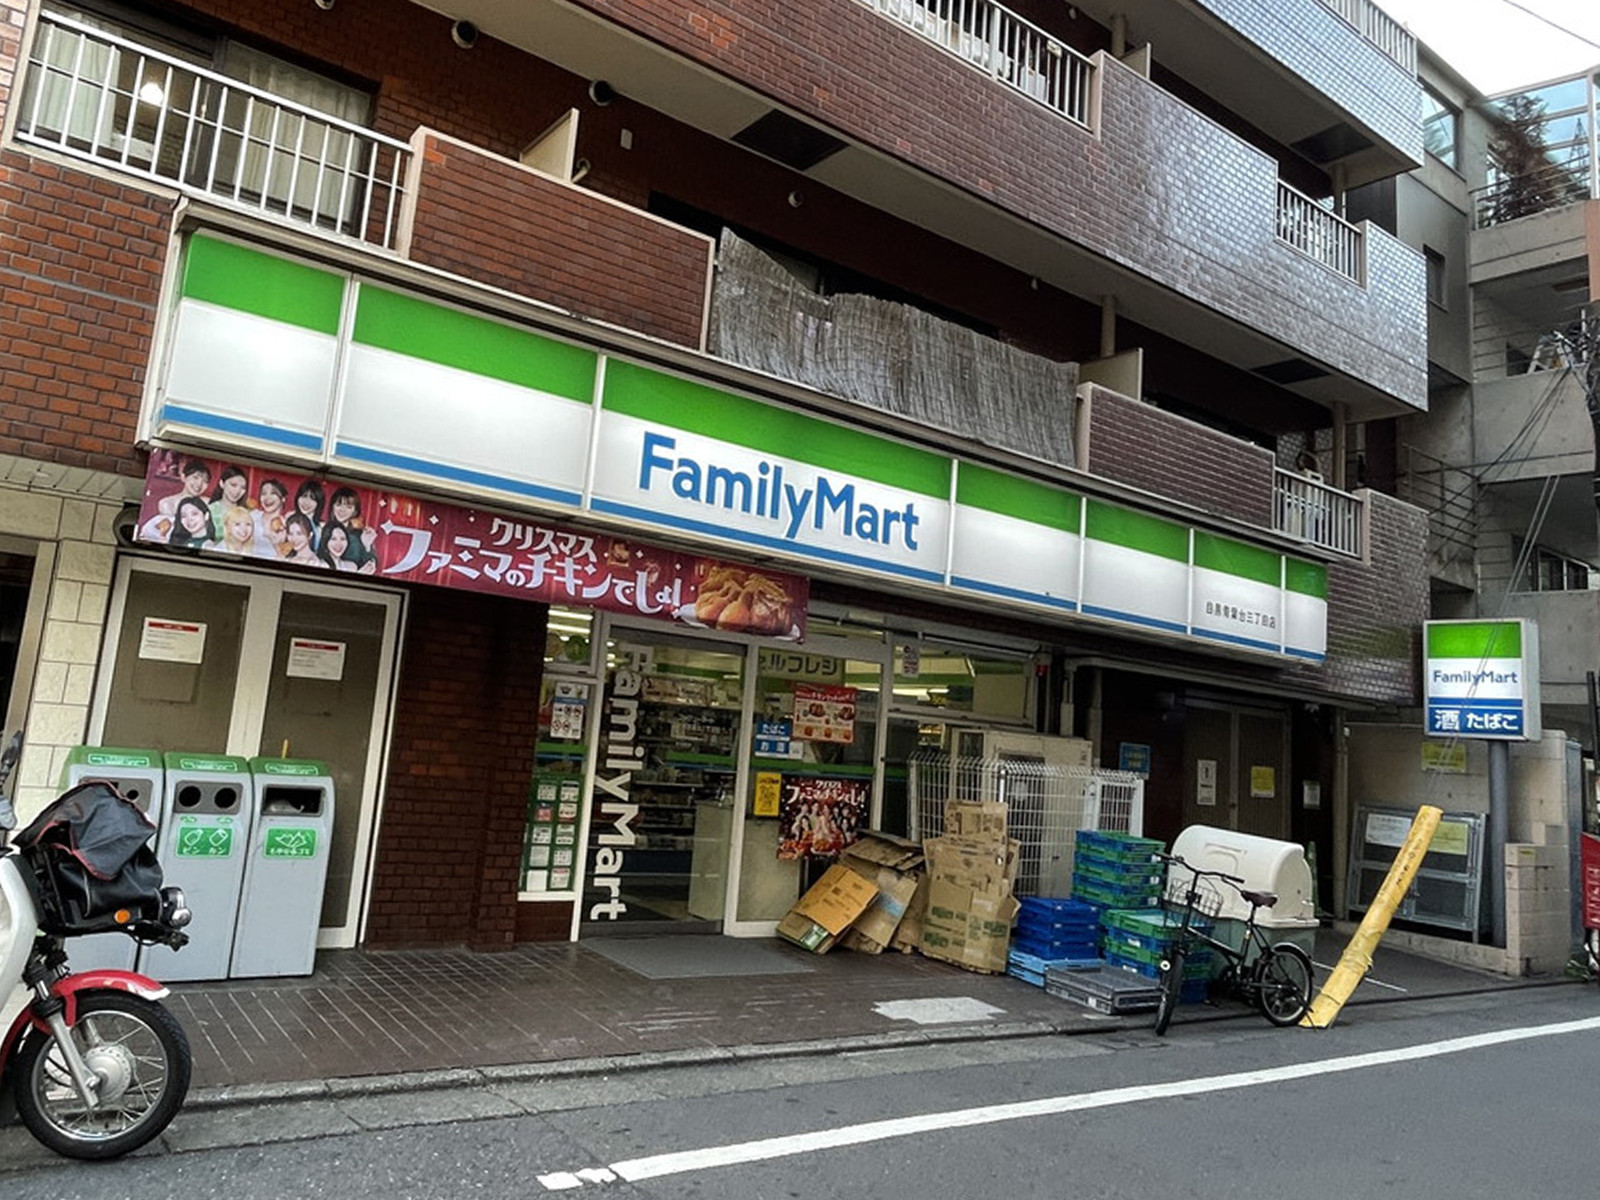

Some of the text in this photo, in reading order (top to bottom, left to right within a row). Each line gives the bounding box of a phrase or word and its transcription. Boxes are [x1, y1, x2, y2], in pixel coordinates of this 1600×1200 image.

[639, 431, 920, 551] FamilyMart
[489, 517, 598, 564] クリスマス
[1433, 670, 1518, 686] FamilyMart
[1434, 709, 1519, 730] 酒 たばこ
[590, 644, 654, 921] FamilyMart
